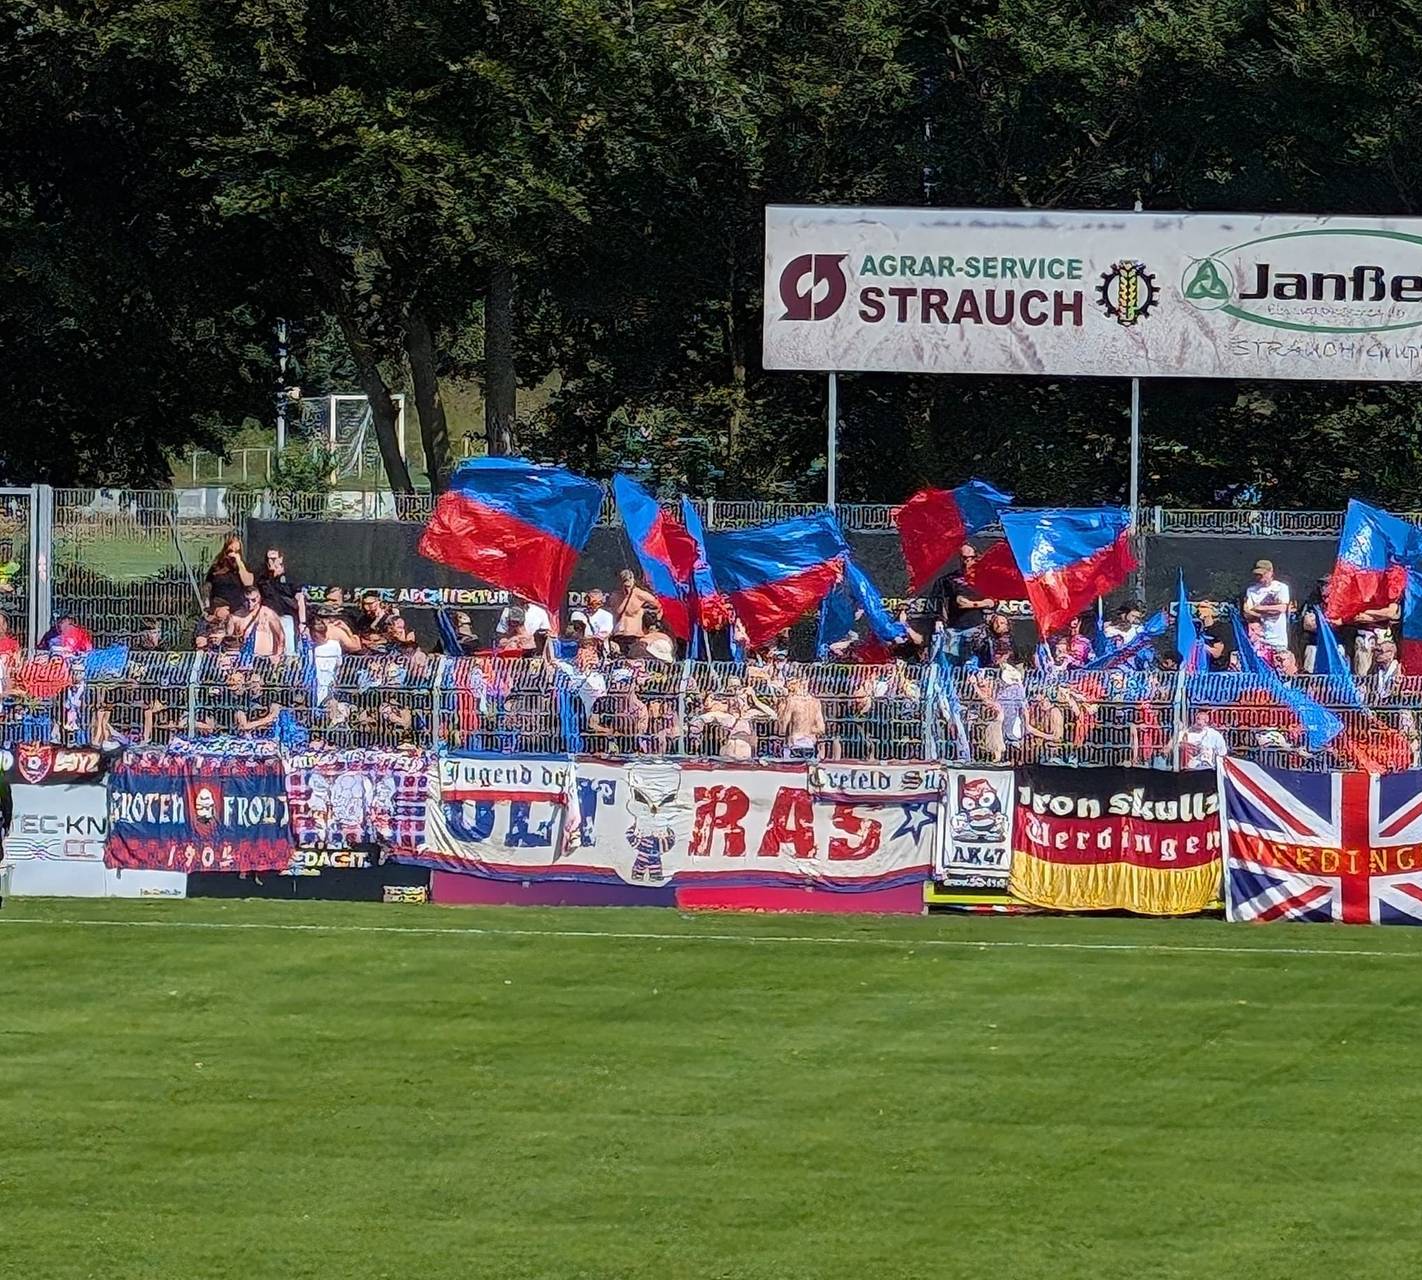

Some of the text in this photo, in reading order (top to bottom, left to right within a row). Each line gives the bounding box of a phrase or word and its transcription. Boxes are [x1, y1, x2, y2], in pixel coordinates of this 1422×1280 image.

[860, 255, 1082, 280] AGRAR-SERVICE
[860, 287, 1083, 326] STRAUCH
[442, 761, 532, 788] Jugend
[223, 795, 289, 827] FRONT
[1018, 786, 1100, 819] Iron
